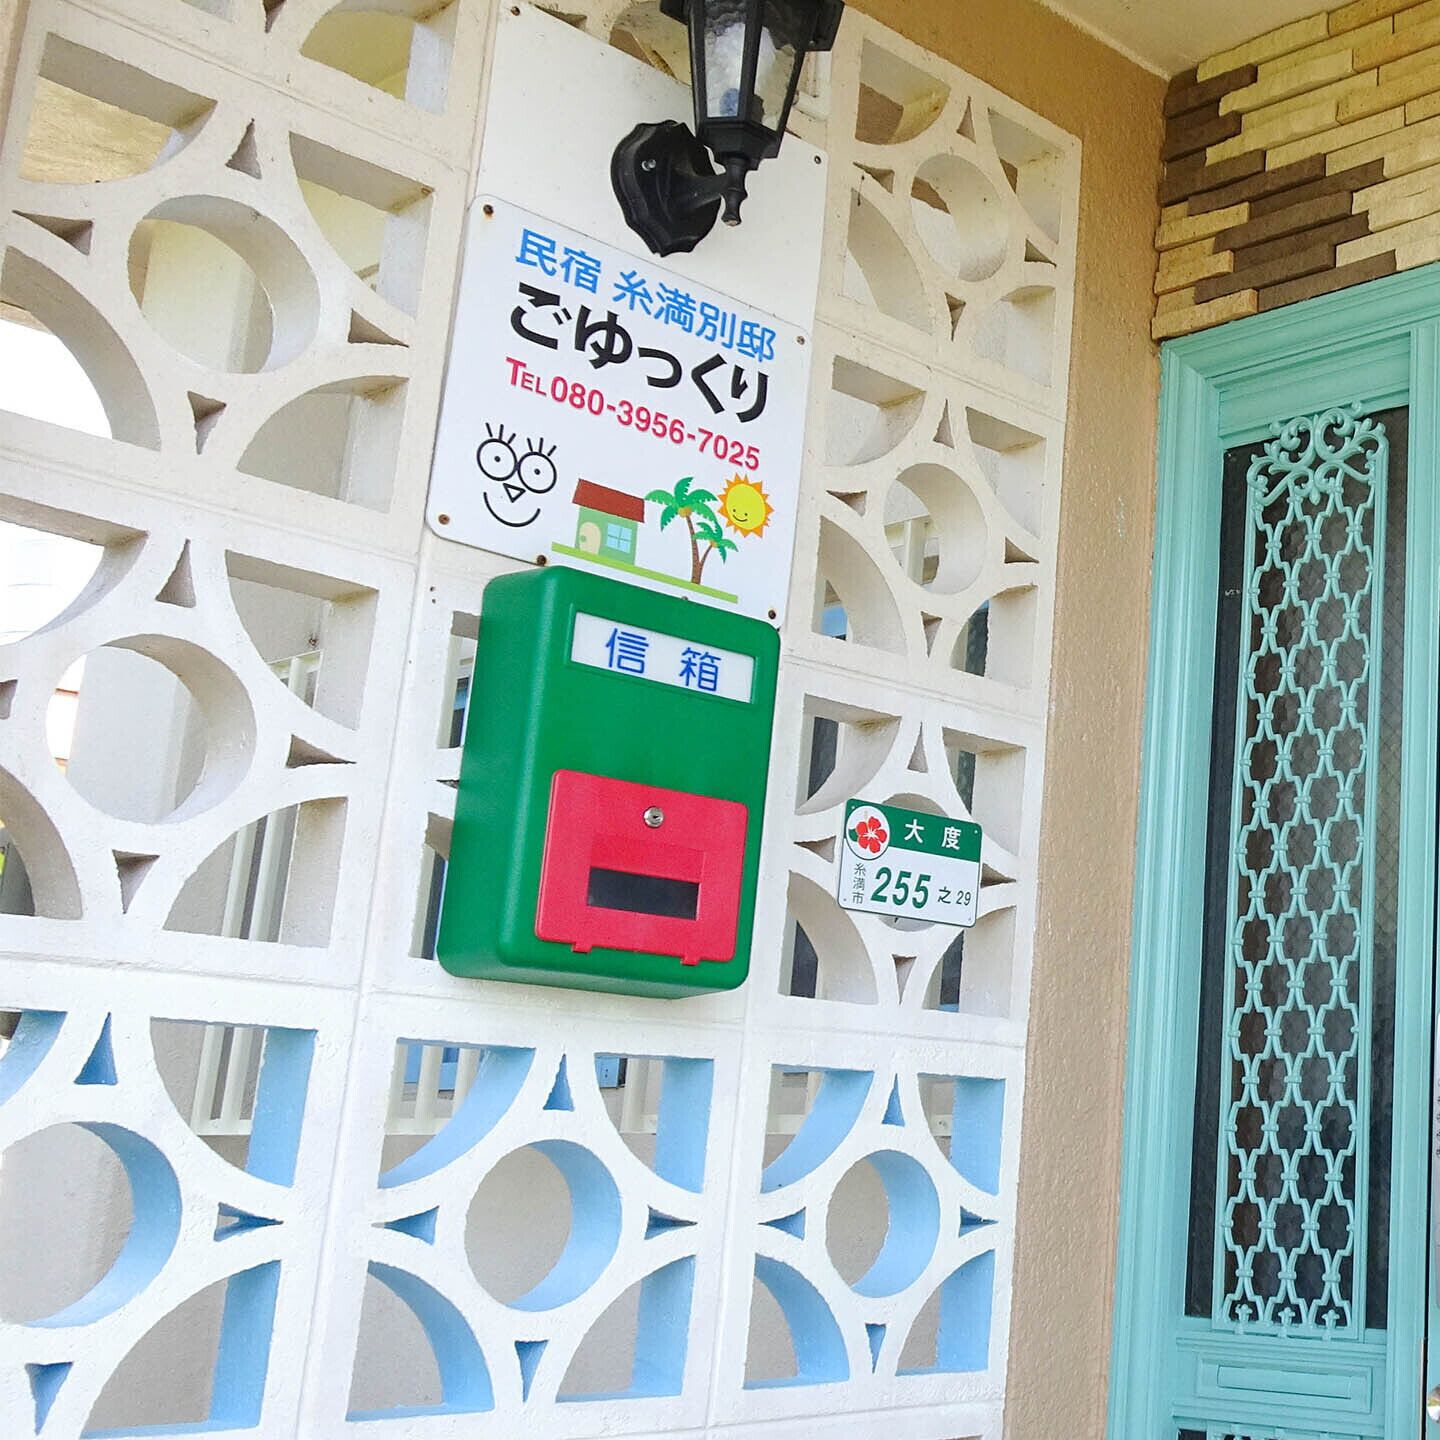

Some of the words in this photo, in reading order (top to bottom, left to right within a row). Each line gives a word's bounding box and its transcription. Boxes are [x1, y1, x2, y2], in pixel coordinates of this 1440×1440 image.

[510, 282, 768, 423] ごゆっくり
[515, 229, 602, 294] 民宿
[612, 271, 776, 363] 糸満別邸
[870, 866, 932, 909] 255
